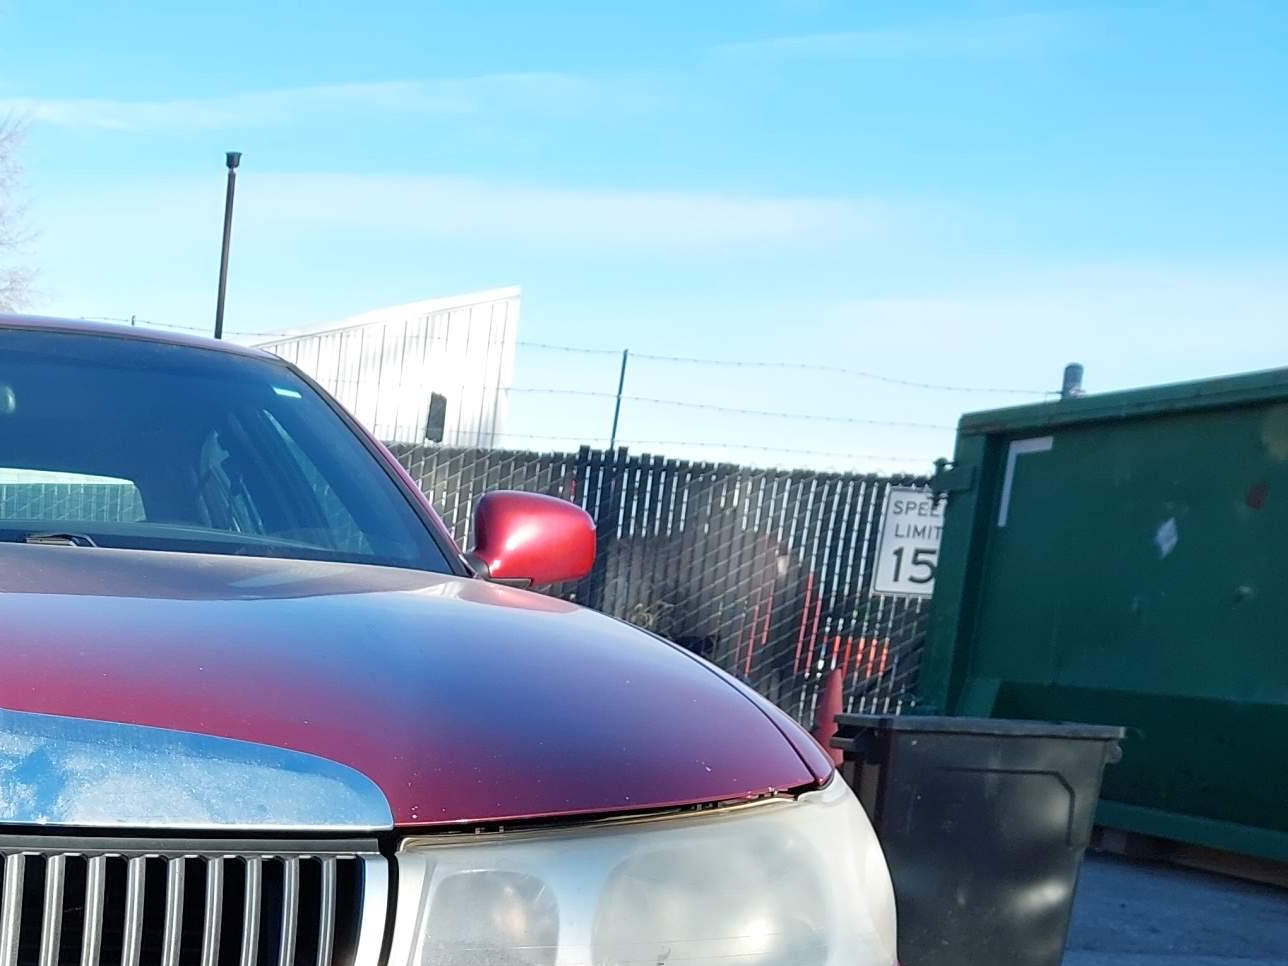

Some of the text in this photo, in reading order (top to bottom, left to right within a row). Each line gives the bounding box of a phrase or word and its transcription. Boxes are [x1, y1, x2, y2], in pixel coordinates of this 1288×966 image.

[892, 500, 941, 517] SPEE
[894, 522, 943, 540] LIMIT
[892, 546, 937, 584] 15
